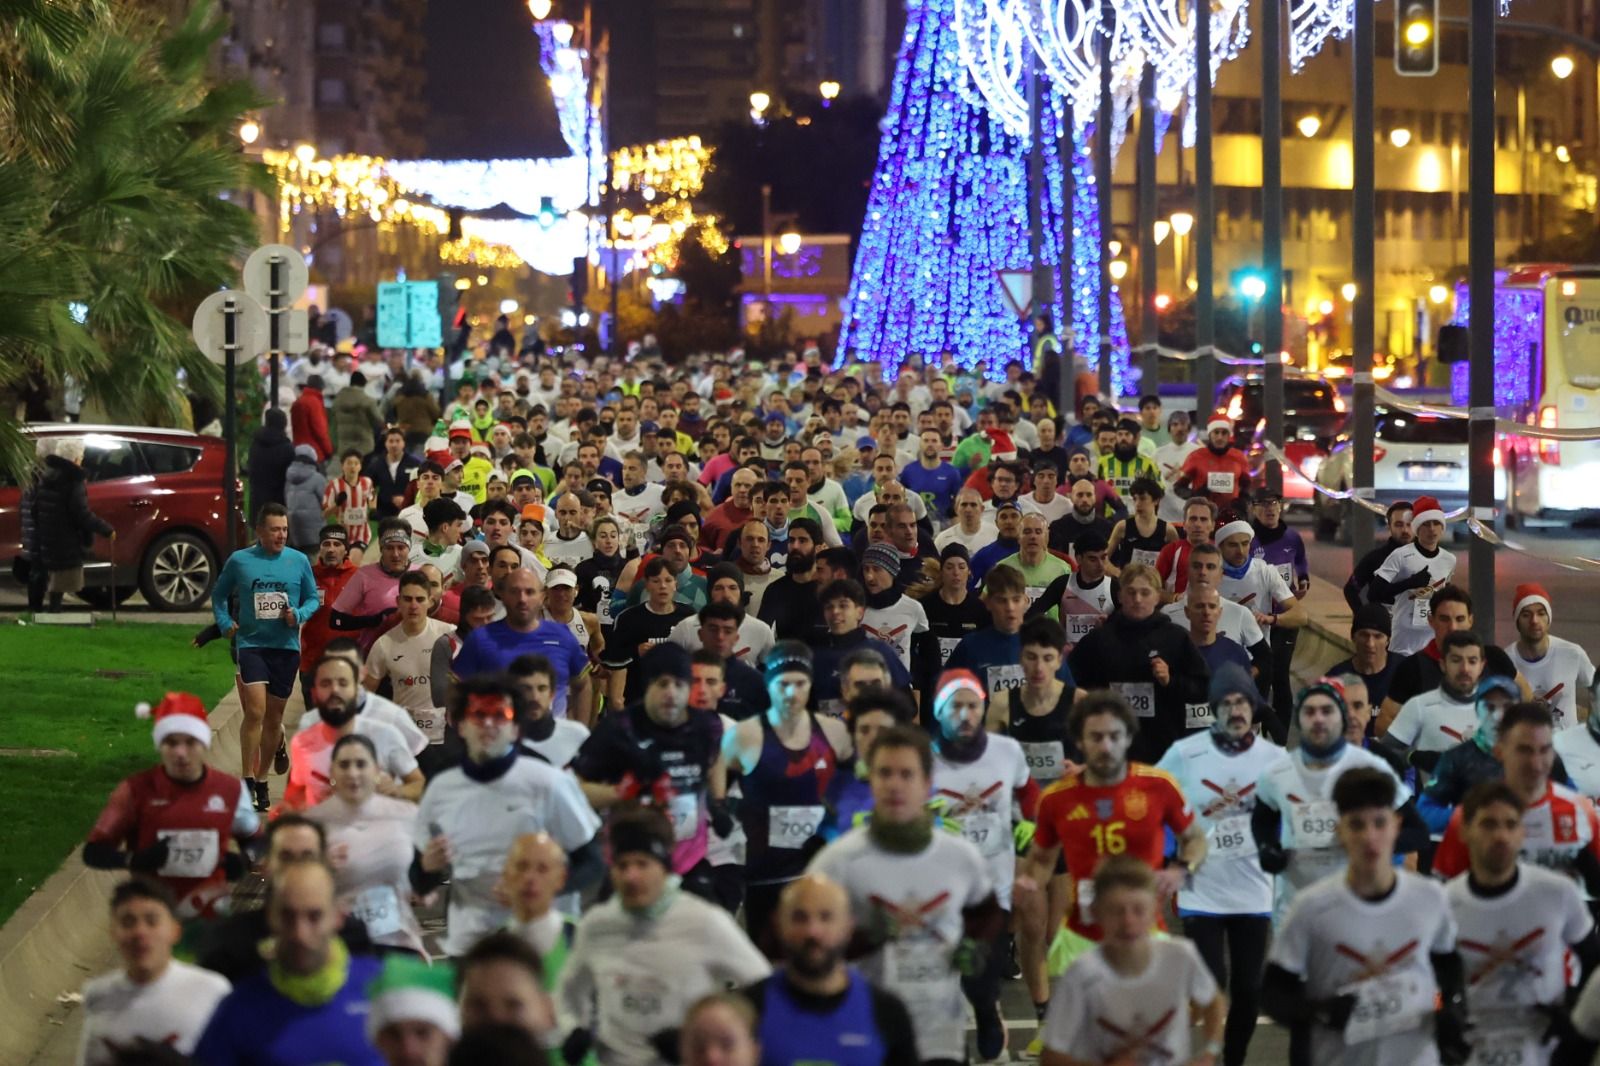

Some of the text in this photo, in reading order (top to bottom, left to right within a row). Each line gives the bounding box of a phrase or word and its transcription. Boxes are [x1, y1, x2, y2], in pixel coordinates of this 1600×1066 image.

[258, 601, 284, 611] 1206
[1124, 696, 1150, 710] 28
[1026, 756, 1055, 768] 935
[781, 822, 815, 836] 700
[1302, 818, 1337, 834] 639
[1090, 822, 1126, 855] 16
[1215, 831, 1245, 848] 185
[173, 848, 204, 865] 757
